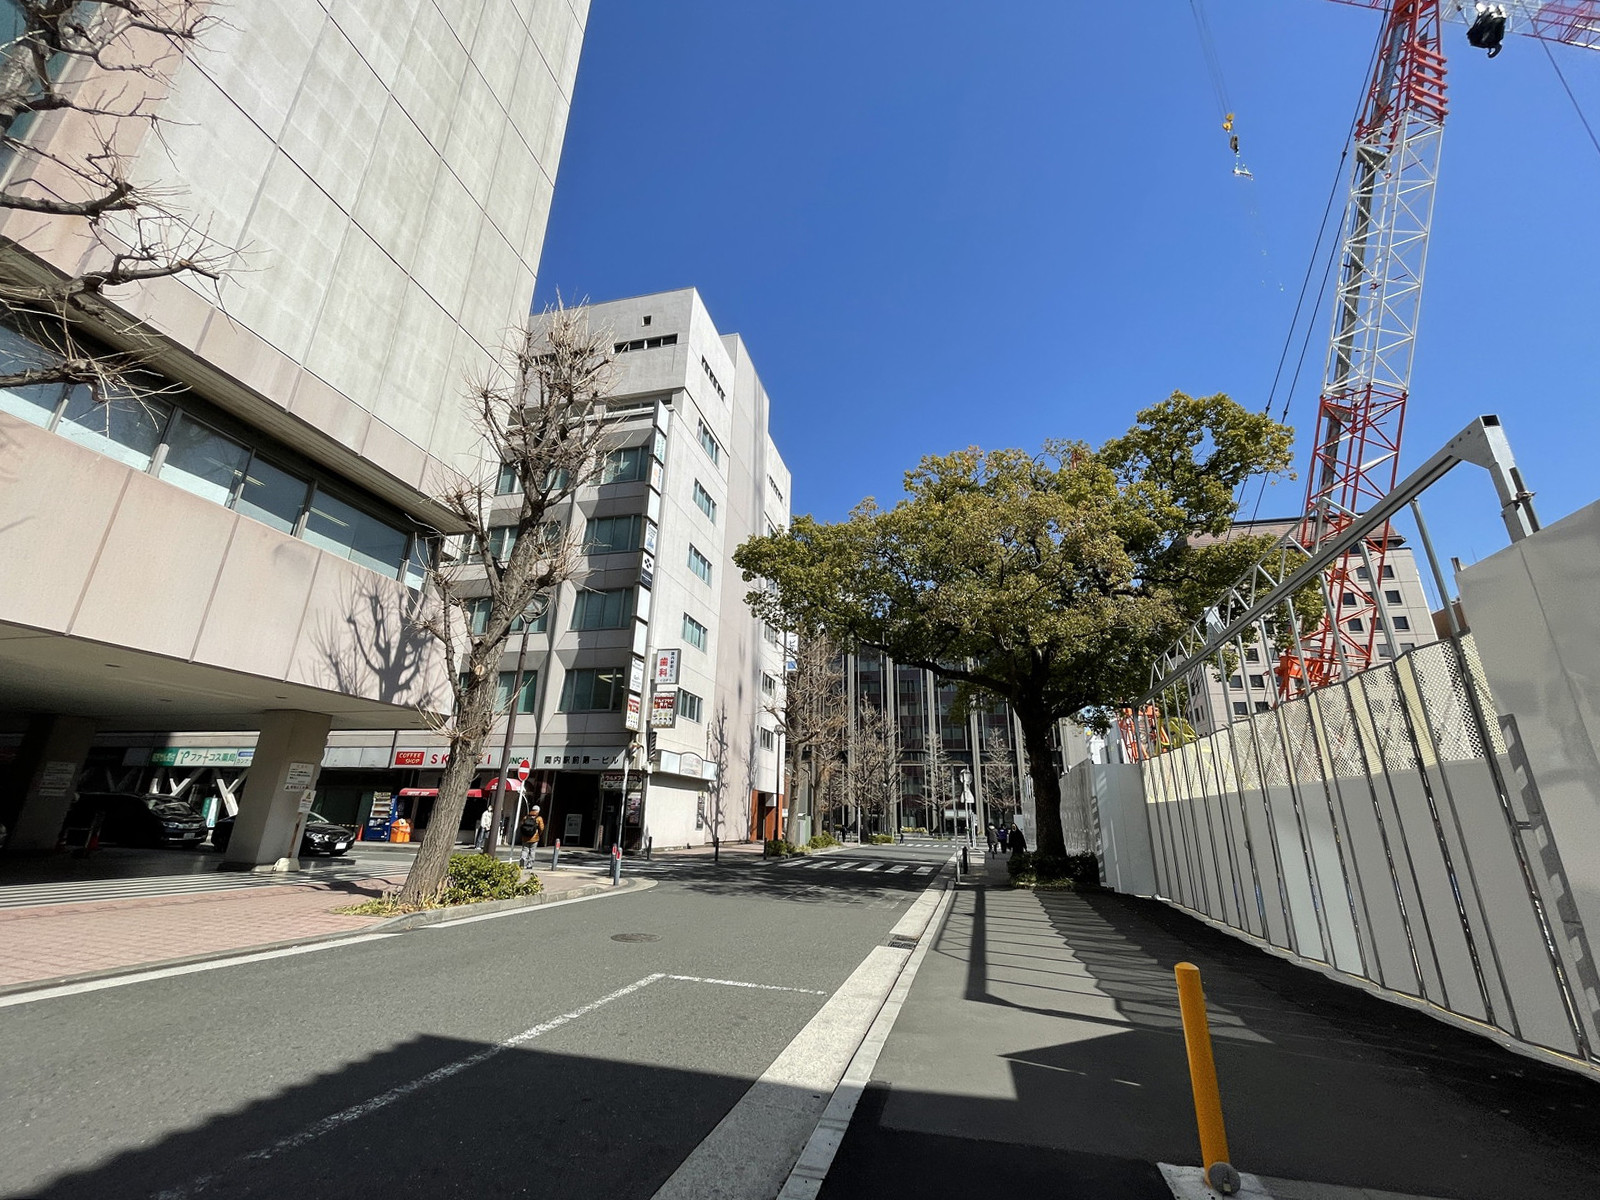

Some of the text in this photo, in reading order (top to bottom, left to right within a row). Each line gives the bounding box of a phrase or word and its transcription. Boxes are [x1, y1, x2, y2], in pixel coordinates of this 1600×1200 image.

[659, 656, 668, 677] 歯科
[190, 753, 236, 762] ファーコス薬局
[544, 756, 619, 764] 関内駅前第一ビル
